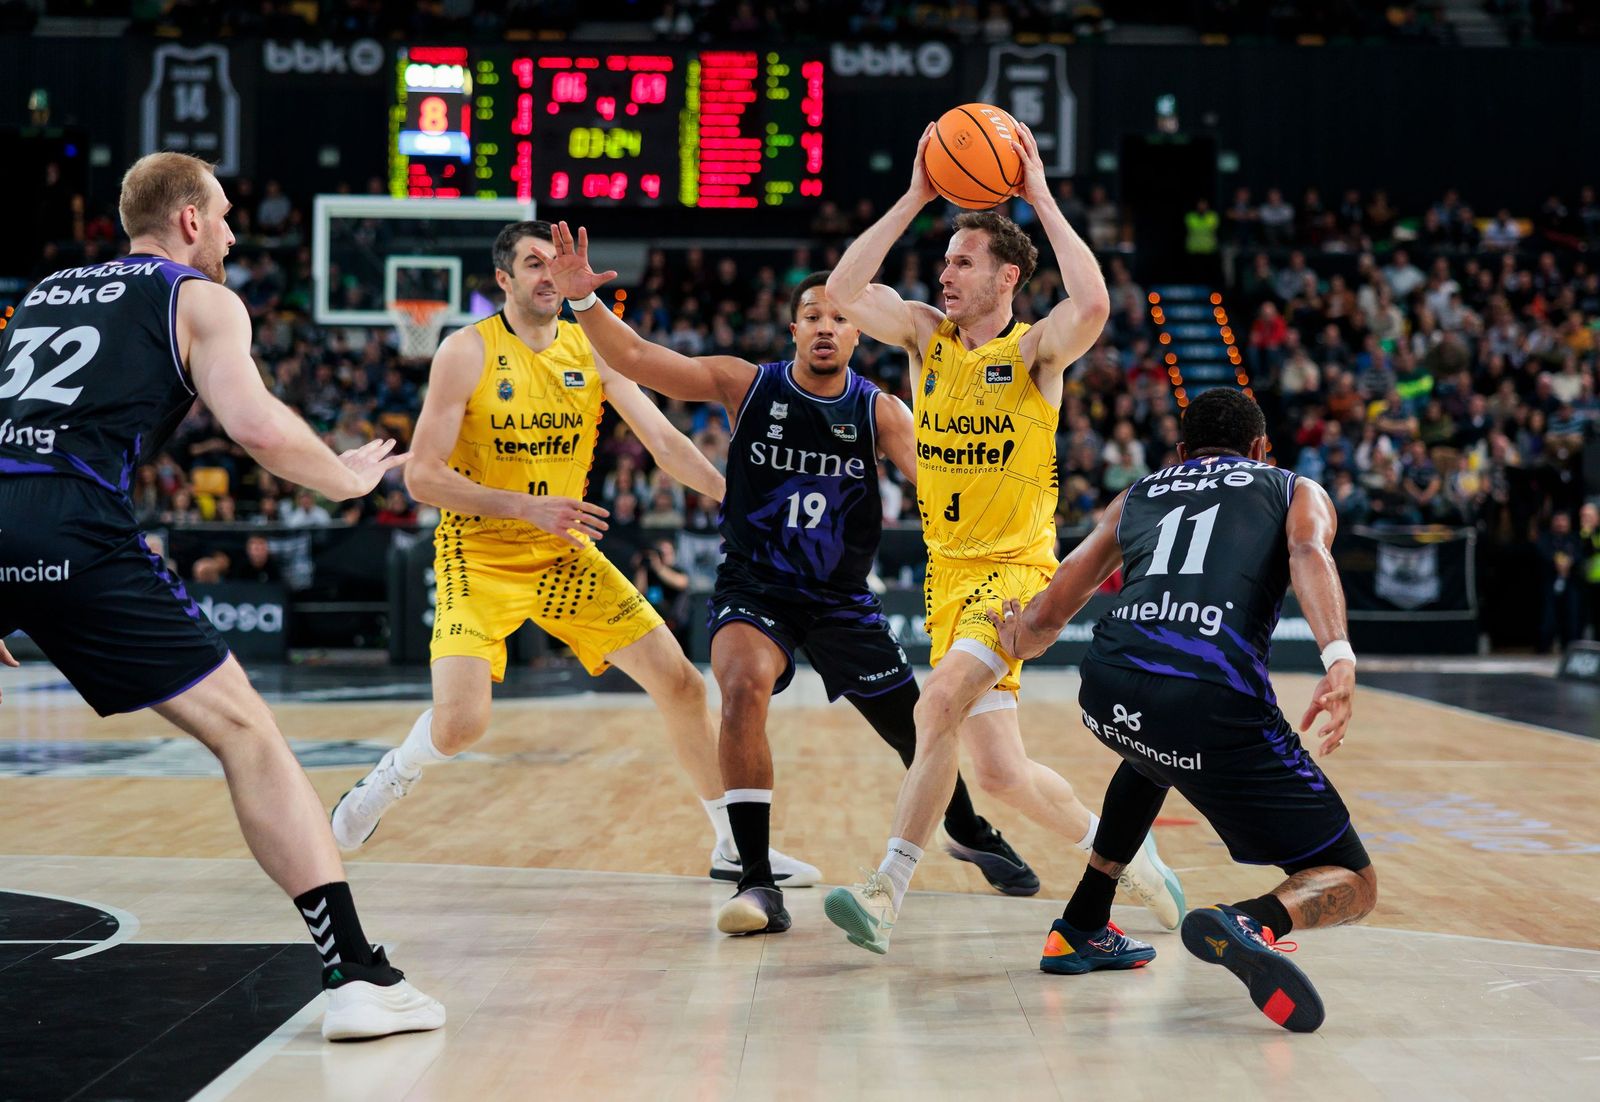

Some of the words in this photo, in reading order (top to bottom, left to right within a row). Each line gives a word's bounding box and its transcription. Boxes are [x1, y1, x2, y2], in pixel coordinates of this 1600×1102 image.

[24, 285, 96, 307] bbk
[0, 325, 101, 406] 32
[491, 414, 516, 429] LA
[521, 412, 583, 430] LAGUNA
[919, 410, 931, 430] A
[935, 414, 1015, 435] LAGUNA
[750, 441, 865, 479] surne
[1147, 478, 1219, 498] bbk
[787, 491, 827, 529] 19
[1145, 503, 1221, 576] 11
[859, 667, 899, 682] NISSAN
[1103, 723, 1202, 770] Financial
